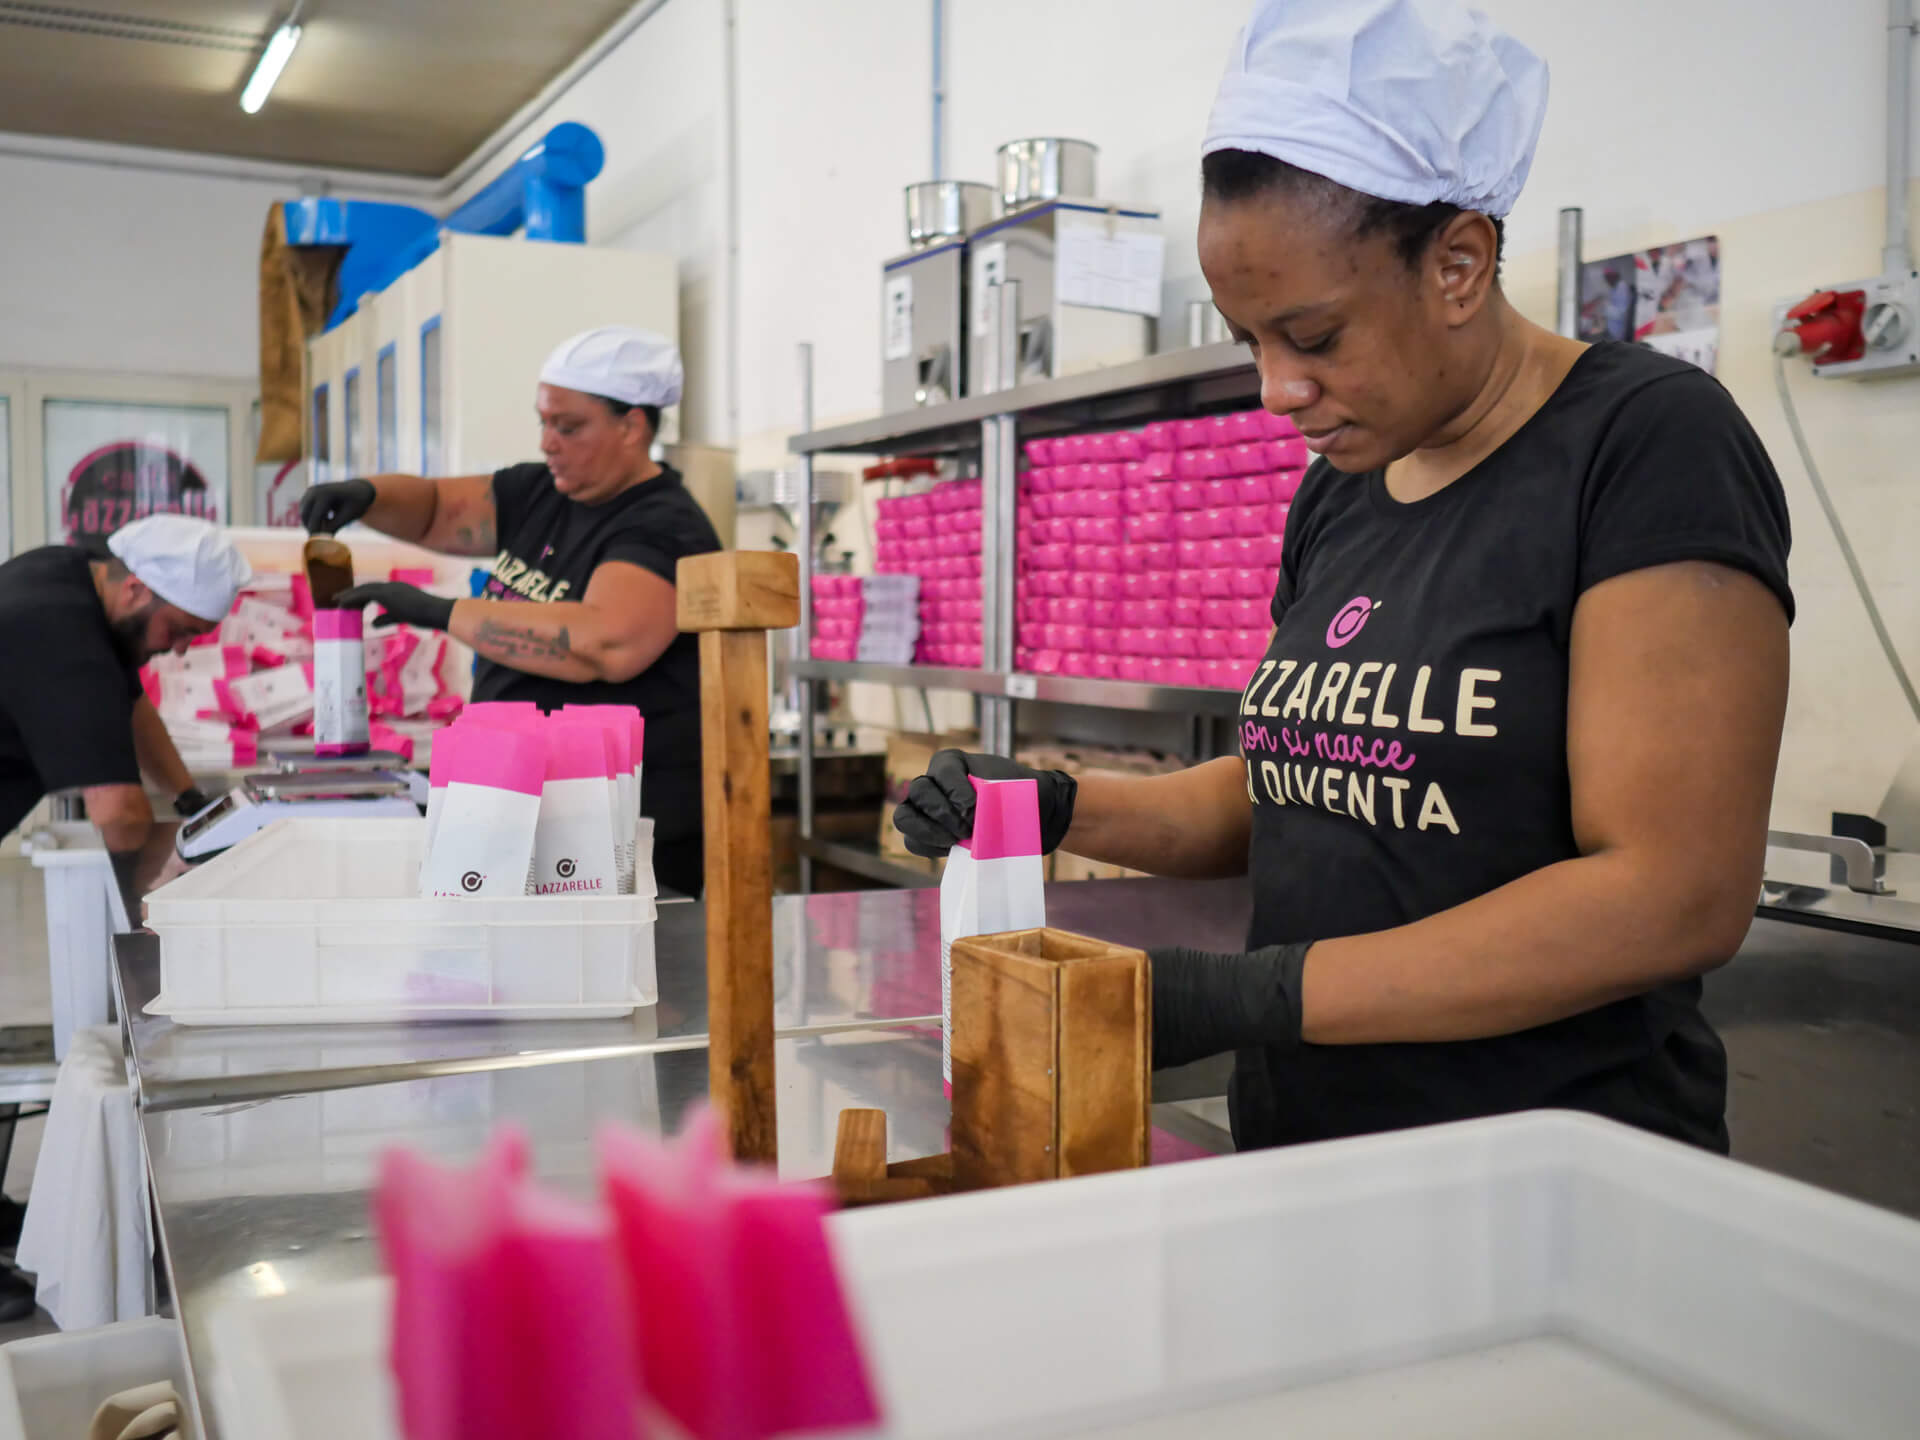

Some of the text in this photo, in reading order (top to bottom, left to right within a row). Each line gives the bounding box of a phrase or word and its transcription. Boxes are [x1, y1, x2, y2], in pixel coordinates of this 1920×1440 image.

[1240, 659, 1502, 737] ZZARELLE
[1281, 719, 1310, 756] si
[1314, 732, 1416, 771] nasce
[1261, 760, 1461, 835] DIVENTA
[535, 878, 603, 895] LAZZARELLE
